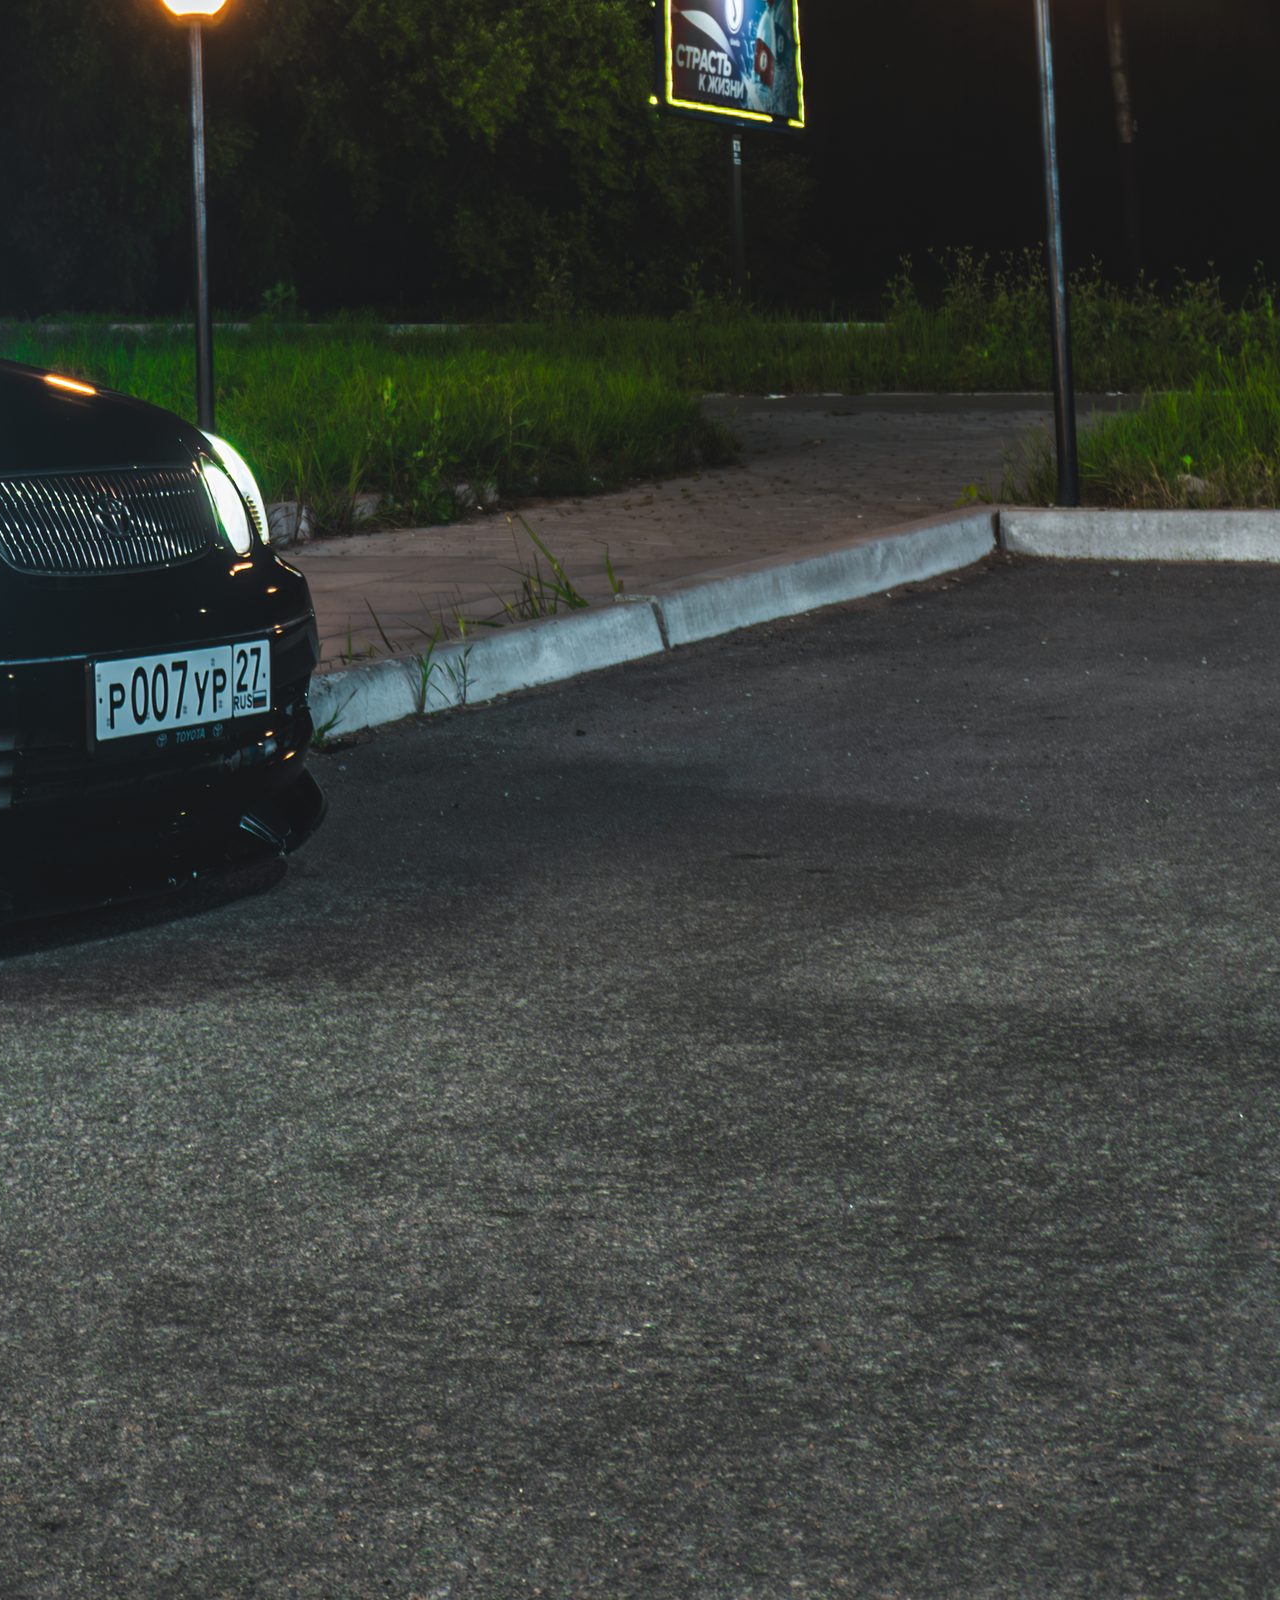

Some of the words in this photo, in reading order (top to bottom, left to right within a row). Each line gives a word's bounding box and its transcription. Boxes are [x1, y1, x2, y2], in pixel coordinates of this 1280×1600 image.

[676, 43, 732, 77] СТРАСТЬ
[698, 73, 707, 92] К
[707, 74, 745, 99] ЖИЗНИ
[109, 660, 227, 730] Р007УР
[236, 647, 262, 693] 27
[233, 694, 253, 711] RUS
[176, 727, 206, 743] TOYOTA
